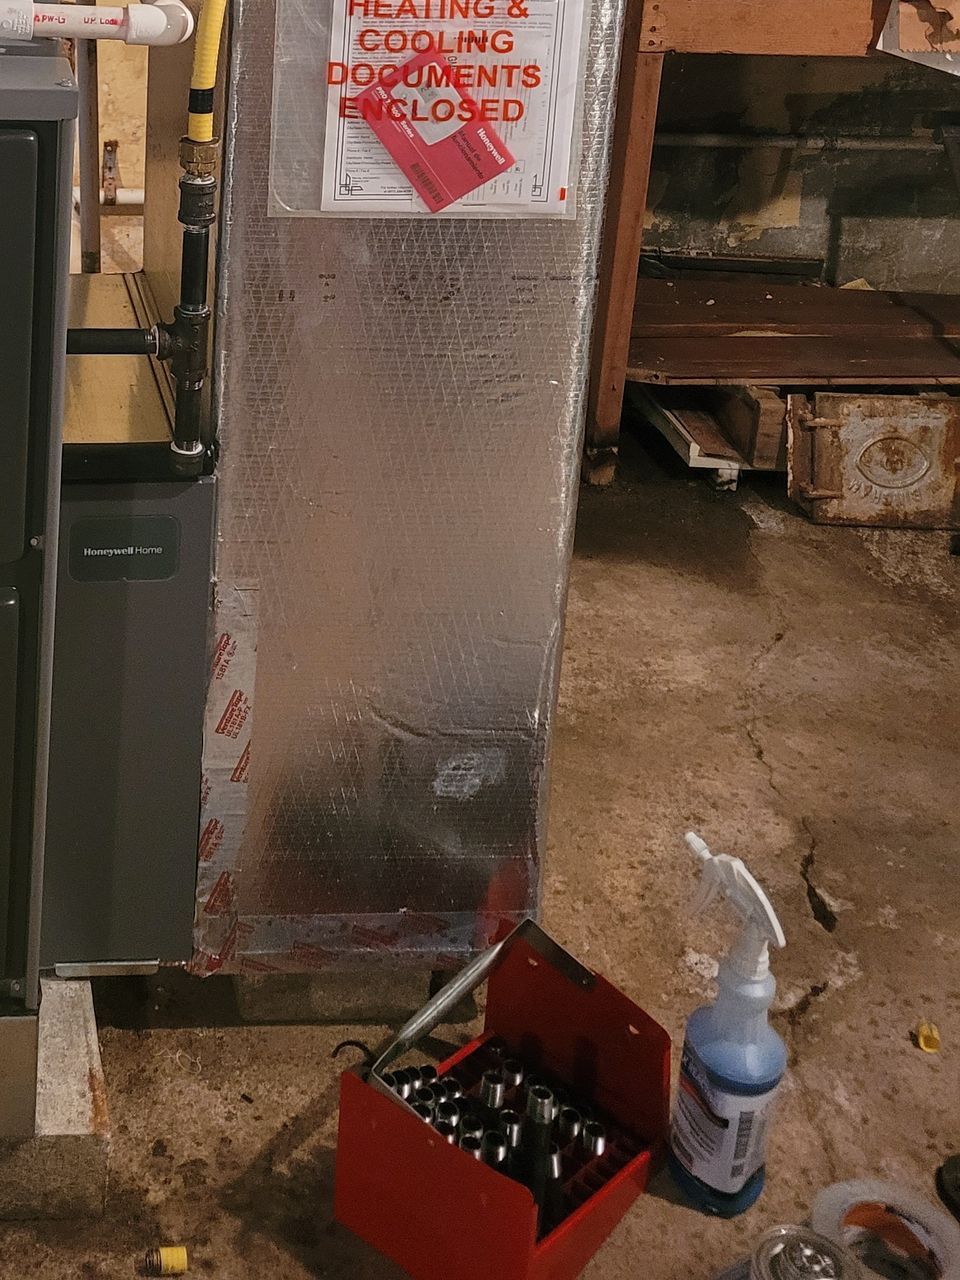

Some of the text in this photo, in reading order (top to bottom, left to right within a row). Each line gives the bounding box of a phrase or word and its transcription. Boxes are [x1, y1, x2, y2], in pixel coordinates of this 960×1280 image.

[359, 29, 514, 54] COOLING
[327, 62, 541, 88] DOCUMENTS
[340, 97, 524, 122] ENCLOSED
[476, 128, 506, 165] Honeywell
[84, 546, 163, 557] Honeywell Home
[216, 659, 231, 680] 1581A
